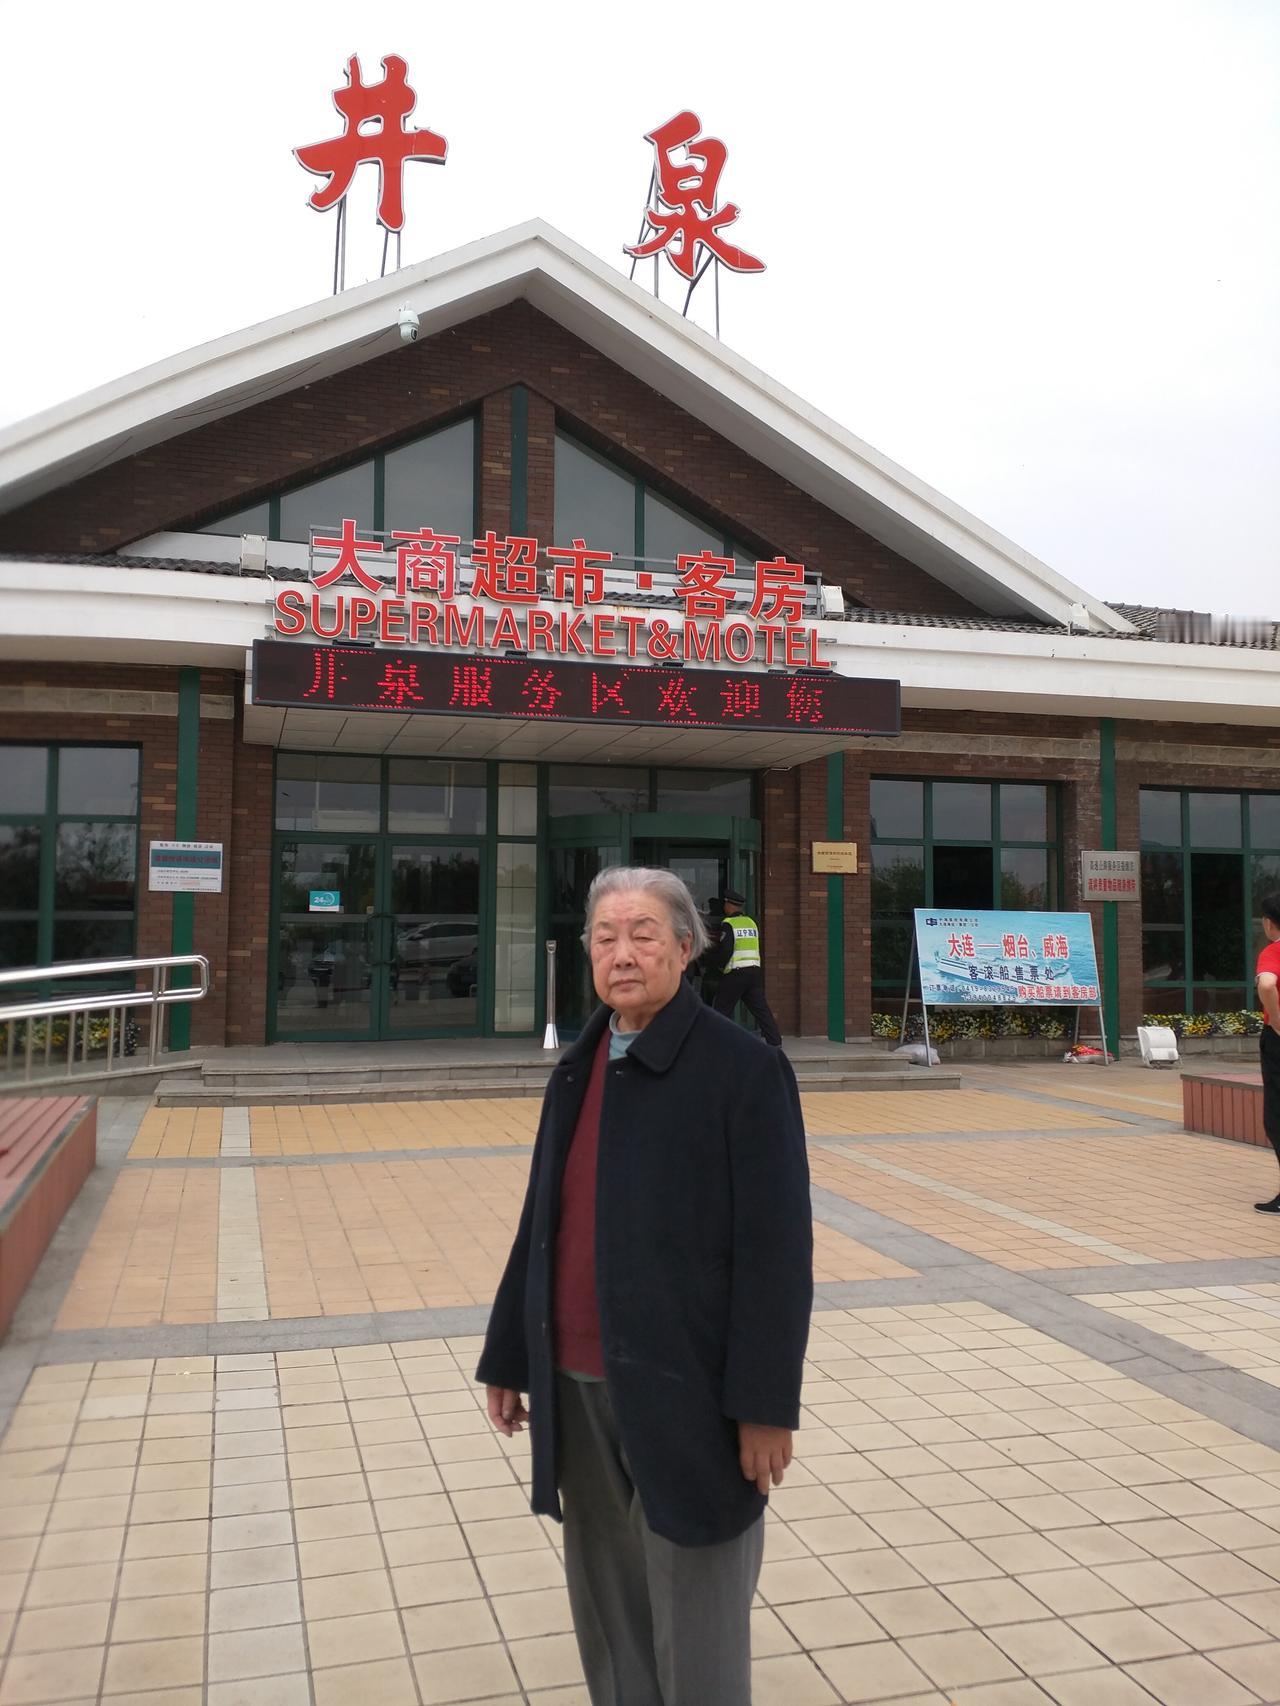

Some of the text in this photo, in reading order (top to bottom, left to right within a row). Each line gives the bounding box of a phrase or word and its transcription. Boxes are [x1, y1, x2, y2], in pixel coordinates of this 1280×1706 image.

[292, 52, 767, 281] 井泉
[274, 588, 832, 668] SUPERMARKET&MOTEL
[968, 965, 1055, 981] 客滚船售票处
[1018, 985, 1097, 1000] 购买船票请到客房部
